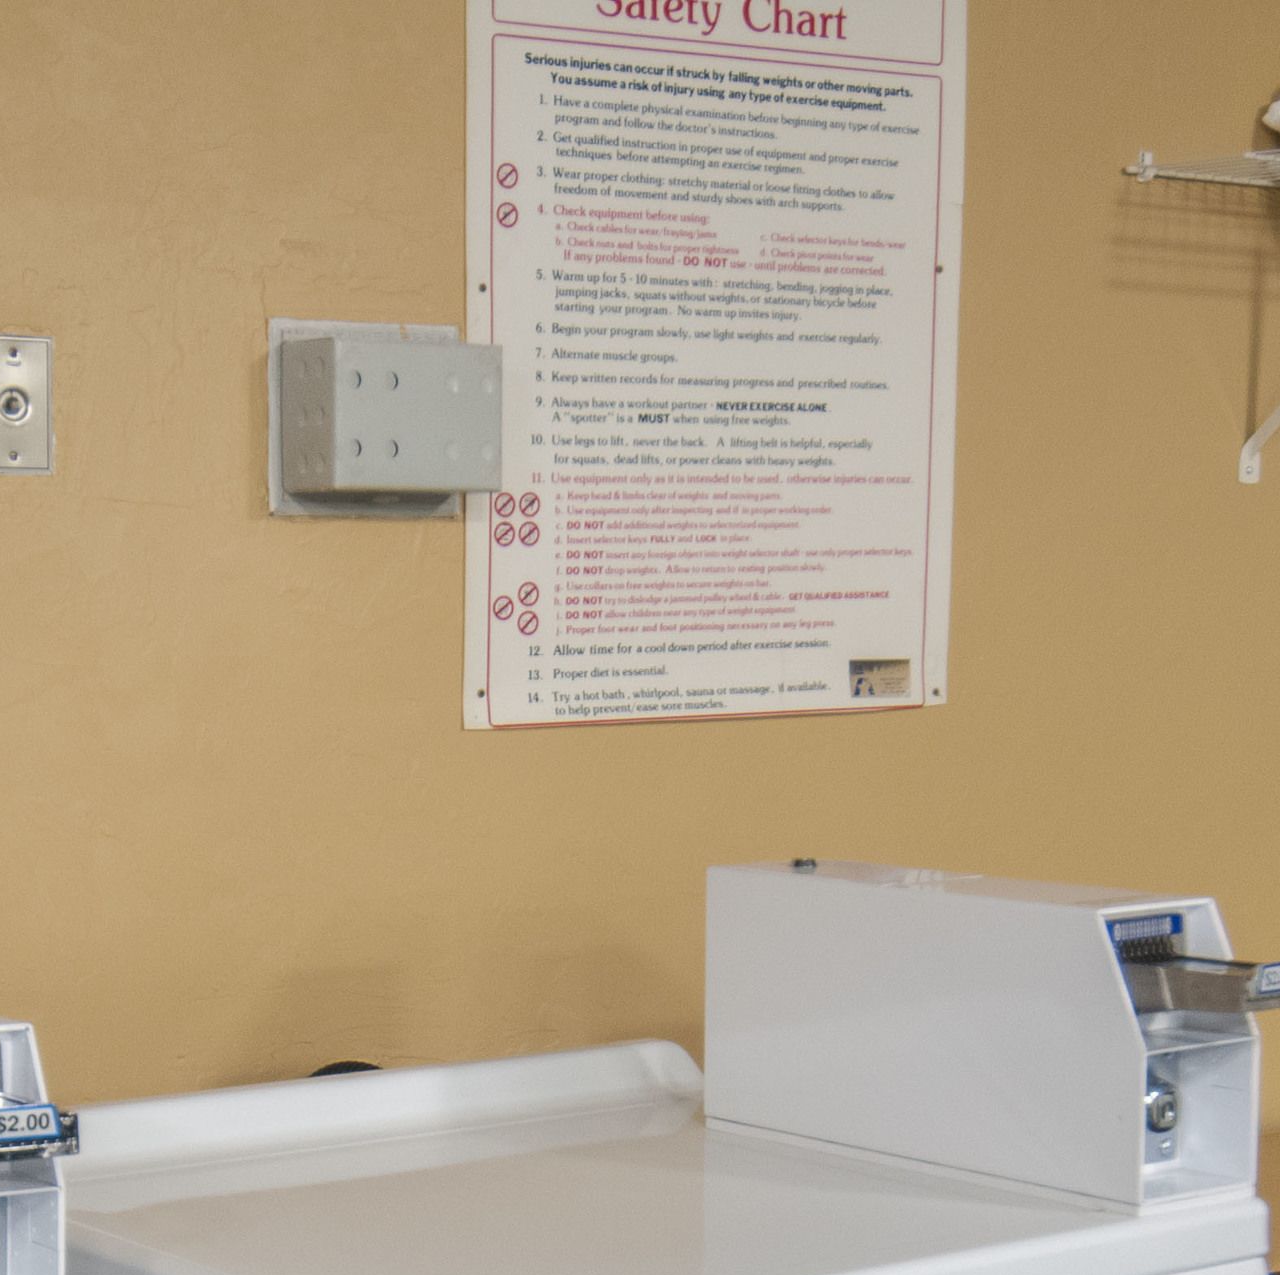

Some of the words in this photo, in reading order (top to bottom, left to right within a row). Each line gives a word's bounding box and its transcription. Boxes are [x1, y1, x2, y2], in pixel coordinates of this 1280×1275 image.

[742, 0, 847, 39] Chart
[525, 53, 567, 67] Serious
[570, 57, 611, 71] injuries
[613, 64, 632, 72] can
[634, 65, 663, 75] occur
[666, 64, 673, 76] if
[676, 66, 710, 78] struck
[712, 68, 724, 82] by
[728, 69, 760, 86] falling
[762, 74, 802, 88] weights
[805, 80, 814, 88] or
[817, 78, 843, 90] other
[846, 82, 882, 97] moving
[551, 72, 572, 84] You
[574, 78, 617, 88] assume
[620, 81, 626, 89] a
[628, 79, 648, 90] risk
[651, 81, 662, 92] of
[664, 81, 694, 97] injury
[696, 85, 724, 100] using
[728, 90, 746, 102] any
[748, 88, 771, 103] type
[773, 91, 784, 102] of
[786, 94, 828, 106] exercise
[553, 95, 580, 107] Have
[592, 99, 638, 113] complete
[641, 101, 683, 116] physical
[685, 106, 745, 119] examination
[748, 109, 778, 122] before
[780, 112, 827, 129] beginning
[829, 119, 846, 131] any
[848, 117, 868, 132] type
[881, 122, 919, 134] exercise
[554, 115, 599, 126] program
[602, 115, 621, 126] and
[624, 116, 654, 128] follow
[657, 118, 672, 129] the
[553, 204, 586, 216] Check
[588, 207, 642, 221] equipment
[645, 209, 677, 221] before
[680, 211, 710, 225] using:
[682, 256, 699, 267] DO
[704, 257, 727, 268] NOT
[551, 348, 599, 360] Alternate
[602, 350, 638, 361] muscle
[552, 397, 589, 411] Always
[592, 397, 615, 408] have
[627, 398, 668, 409] workout
[671, 399, 706, 412] partner
[716, 401, 747, 411] NEVER
[749, 402, 794, 412] EXERCISE
[637, 414, 669, 424] MUST
[673, 413, 699, 424] when
[703, 413, 729, 427] using
[731, 414, 749, 425] free
[529, 644, 544, 655] 12.
[553, 644, 584, 655] Allow
[589, 643, 613, 654] time
[616, 643, 631, 653] for
[644, 641, 666, 653] cool
[668, 641, 694, 652] down
[696, 640, 728, 654] period
[730, 639, 751, 650] after
[754, 638, 792, 650] exercise
[528, 668, 543, 679] 13.
[553, 668, 587, 681] Proper
[590, 666, 608, 677] diet
